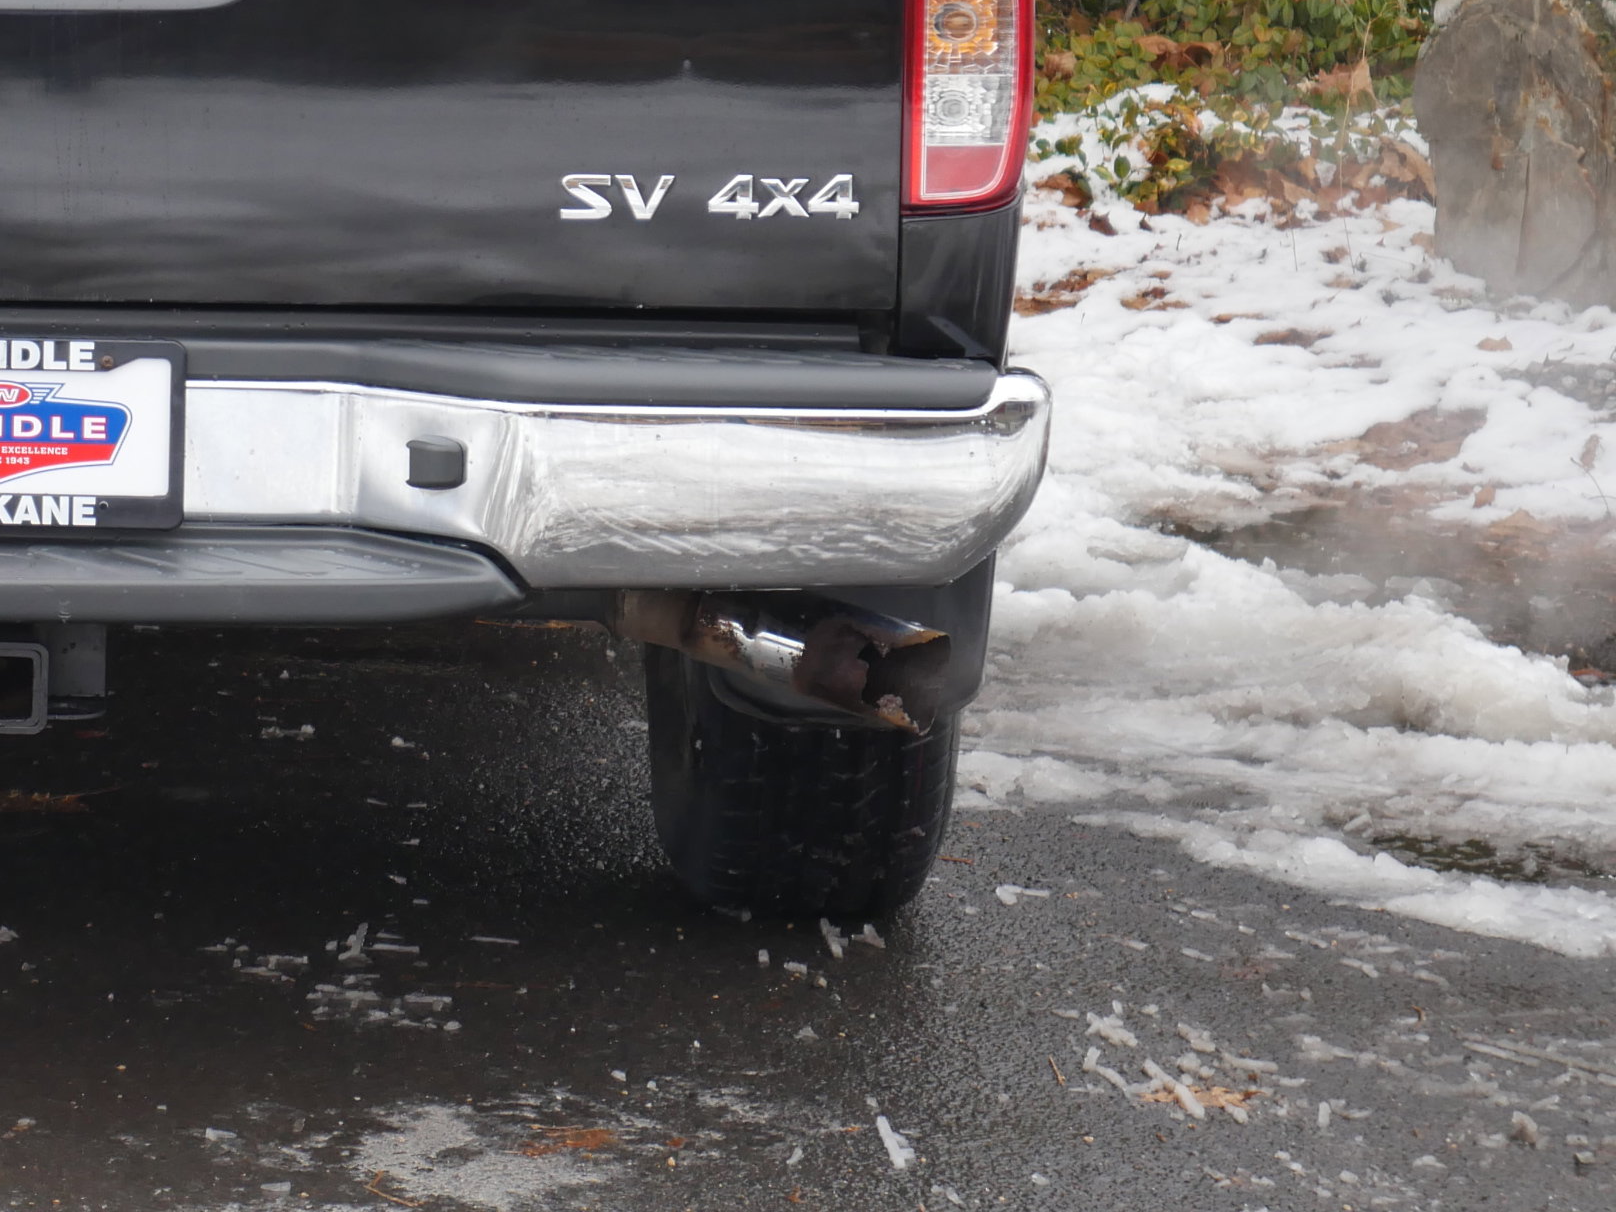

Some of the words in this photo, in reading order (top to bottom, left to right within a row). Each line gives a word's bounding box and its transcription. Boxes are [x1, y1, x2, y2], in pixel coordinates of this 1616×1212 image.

[560, 174, 675, 220] SV
[708, 174, 859, 220] 4x4
[1, 446, 68, 455] EXCELLENCE
[5, 456, 31, 465] 1943
